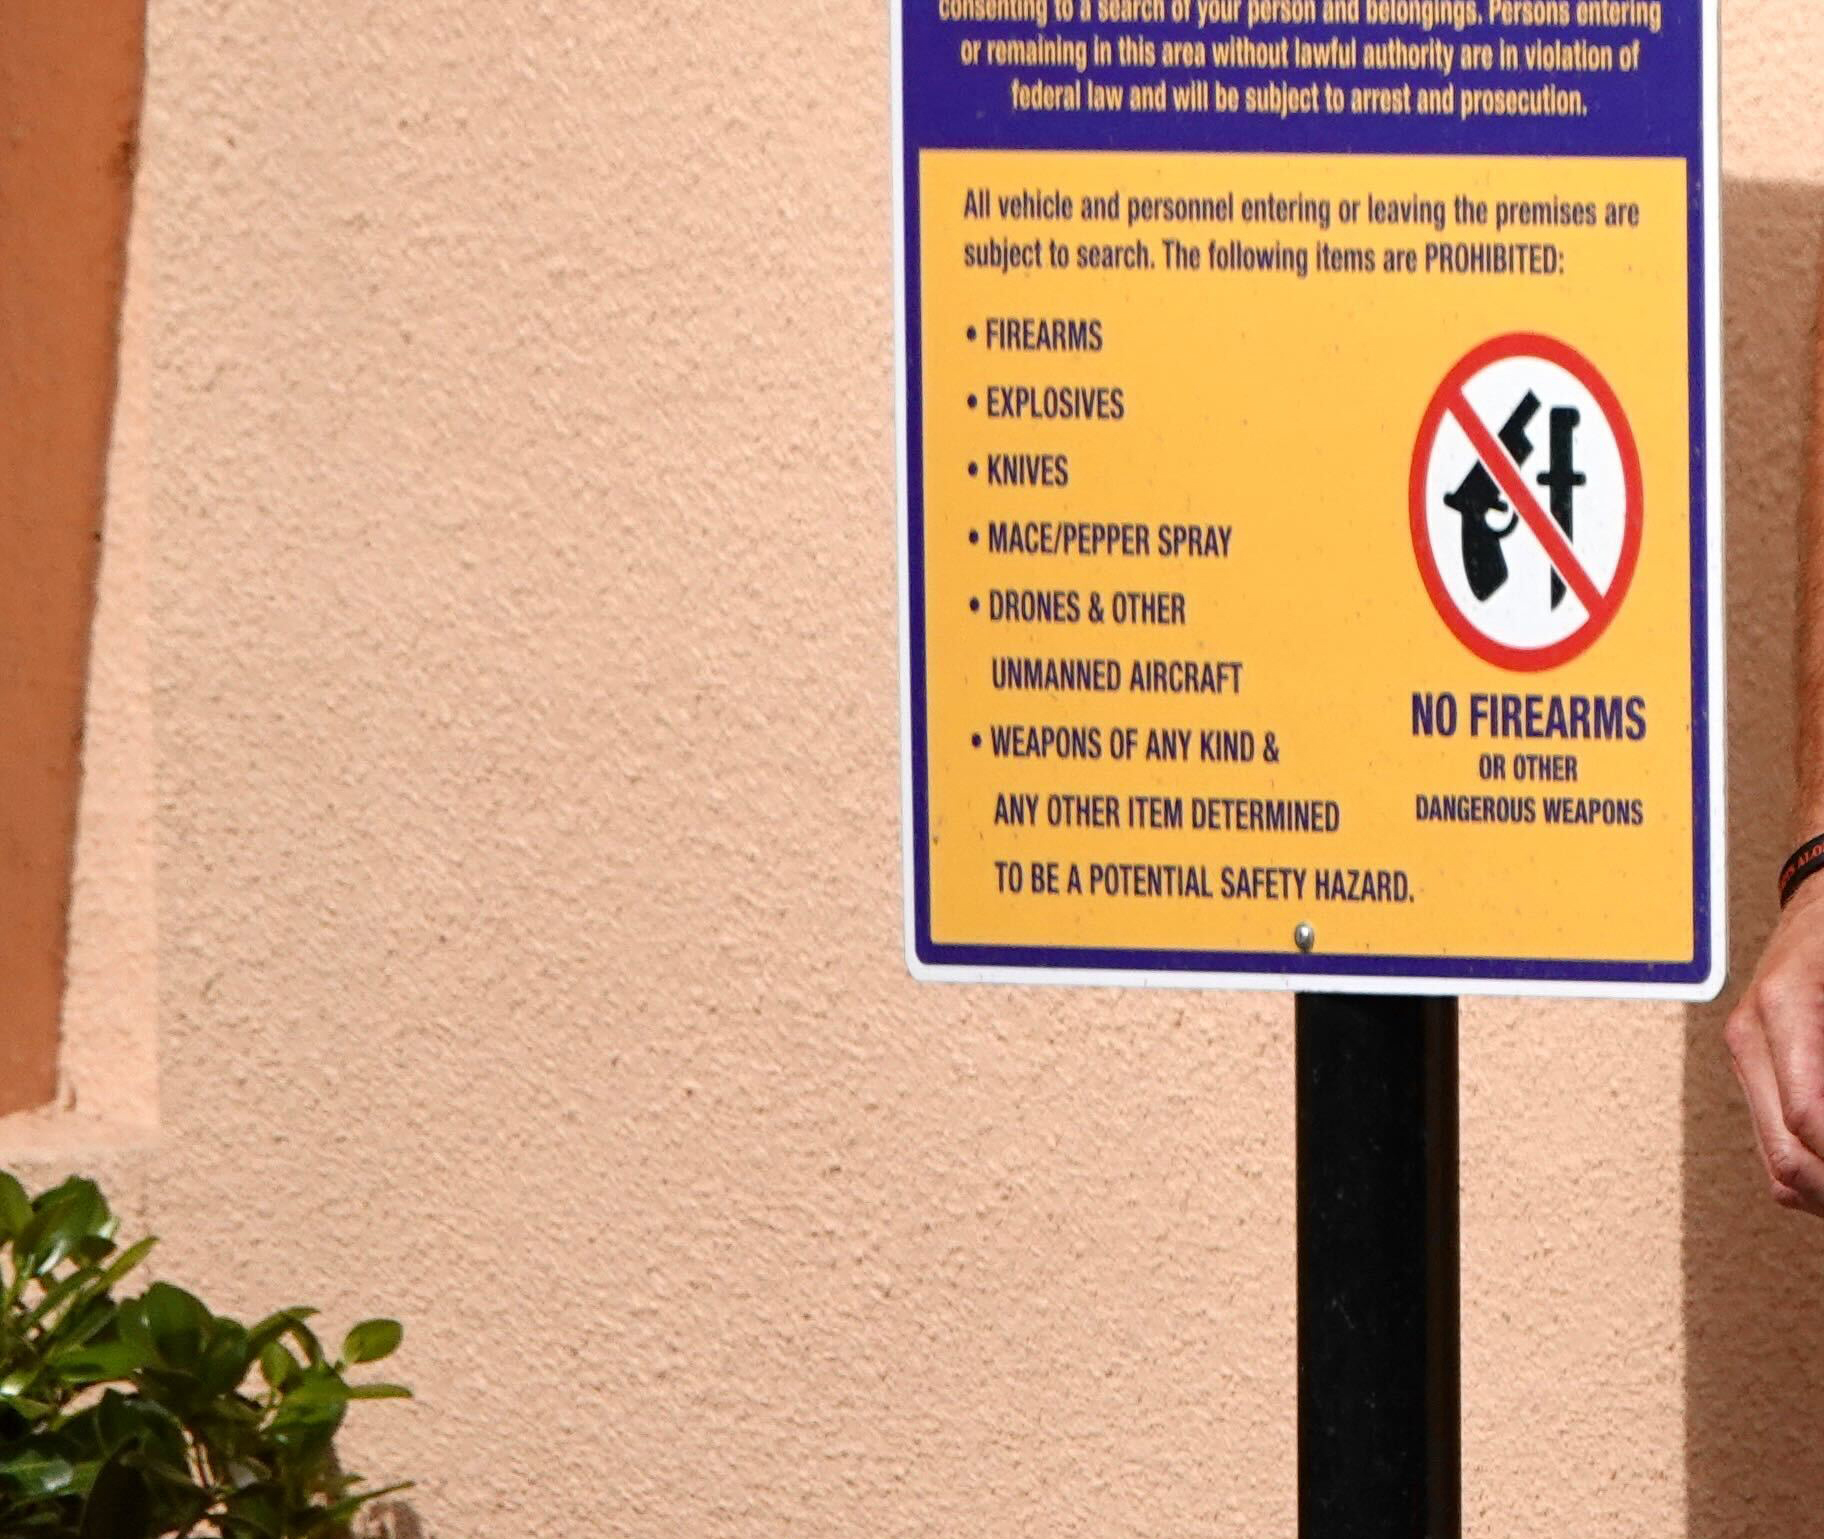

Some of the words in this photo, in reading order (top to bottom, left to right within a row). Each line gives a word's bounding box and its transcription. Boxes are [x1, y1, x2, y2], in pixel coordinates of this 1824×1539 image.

[960, 39, 982, 66] or
[986, 33, 1088, 73] remaining
[1093, 34, 1112, 66] in
[1117, 35, 1156, 67] this
[1161, 41, 1206, 68] area
[1211, 34, 1289, 69] without
[1294, 36, 1357, 69] lawful
[1362, 36, 1455, 77] authority
[1460, 43, 1494, 71] are
[1499, 37, 1519, 71] in
[1524, 38, 1613, 72] violation
[1618, 39, 1641, 72] of
[1011, 78, 1081, 111] federal
[1087, 79, 1124, 112] law
[1129, 79, 1167, 113] and
[1172, 79, 1209, 112] will
[1214, 79, 1240, 113] be
[1244, 80, 1320, 120] subject
[1324, 82, 1345, 114] to
[1350, 82, 1412, 115] arrest
[1416, 82, 1455, 115] and
[1460, 83, 1588, 121] prosecution.
[963, 188, 991, 219] All
[998, 189, 1074, 221] vehicle
[1080, 190, 1120, 221] and
[1127, 191, 1234, 227] personnel
[1241, 193, 1331, 229] entering
[1338, 199, 1361, 224] or
[1368, 194, 1446, 231] leaving
[1454, 195, 1488, 225] the
[1495, 201, 1597, 231] premises
[1604, 202, 1640, 226] are
[964, 237, 1043, 274] subject
[1048, 239, 1070, 269] to
[1076, 239, 1155, 269] search.
[1161, 239, 1201, 270] The
[1208, 239, 1308, 278] following
[1316, 242, 1376, 273] items
[1383, 249, 1418, 273] are
[1425, 242, 1564, 274] PROHIBITED:
[986, 317, 1104, 352] FIREARMS
[986, 385, 1125, 421] EXPLOSIVES
[987, 453, 1069, 488] KNIVES
[988, 520, 1150, 557] MACE/PEPPER
[1157, 523, 1233, 558] SPRAY
[989, 588, 1081, 624] DRONES
[1087, 591, 1105, 625] &
[1111, 591, 1186, 625] OTHER
[991, 655, 1122, 692] UNMANNED
[1129, 659, 1244, 694] AIRCRAFT
[1411, 691, 1458, 737] NO
[1469, 692, 1647, 742] FIREARMS
[990, 724, 1103, 761] WEAPONS
[1109, 726, 1139, 761] OF
[1145, 727, 1193, 762] ANY
[1200, 729, 1255, 763] KIND
[1262, 730, 1280, 763] &
[1478, 752, 1506, 781] OR
[1513, 752, 1578, 783] OTHER
[993, 791, 1040, 827] ANY
[1046, 793, 1121, 829] OTHER
[1128, 795, 1184, 830] ITEM
[1191, 796, 1340, 833] DETERMINED
[1415, 793, 1537, 824] DANGEROUS
[1542, 796, 1644, 826] WEAPONS
[993, 860, 1025, 894] TO
[1030, 861, 1060, 895] BE
[1066, 862, 1083, 895] A
[1089, 862, 1214, 899] POTENTIAL
[1220, 865, 1307, 901] SAFETY
[1314, 868, 1415, 903] HAZARD.
